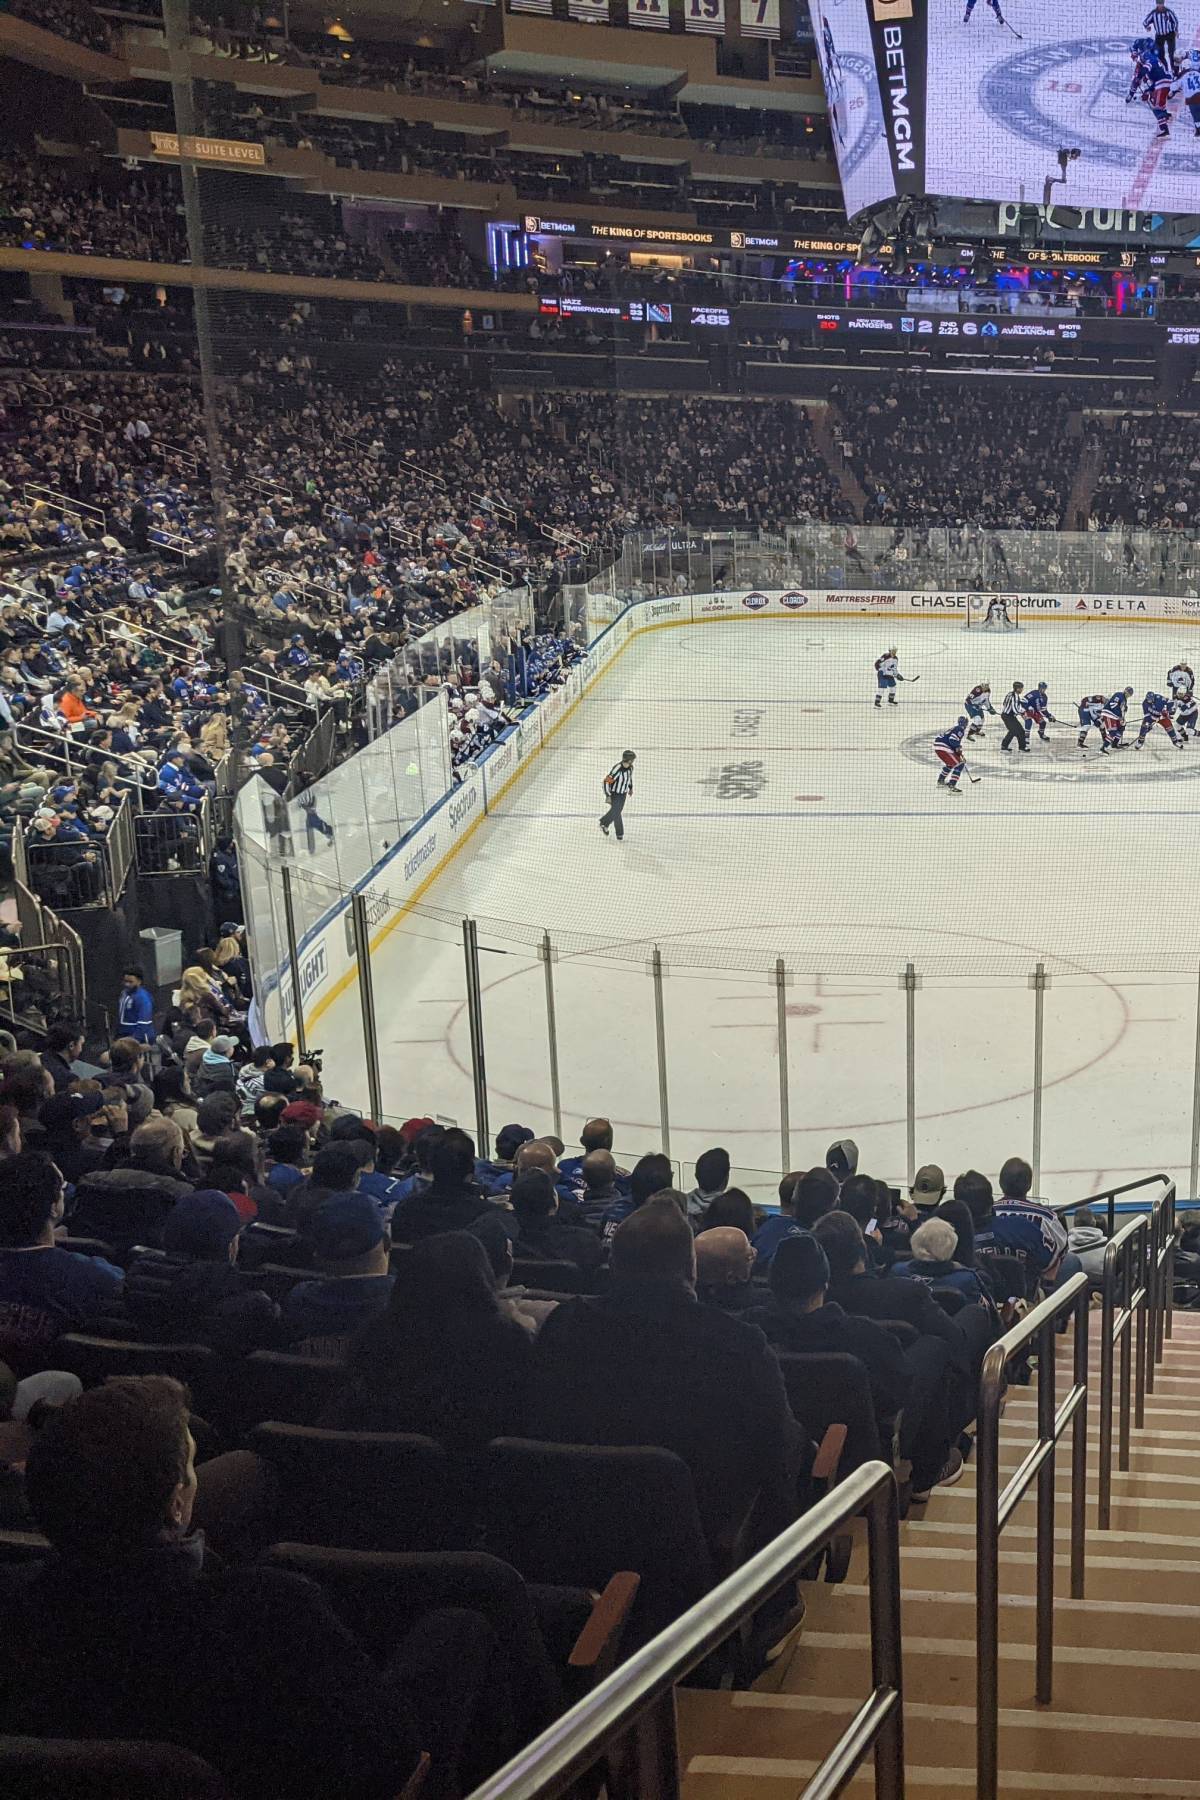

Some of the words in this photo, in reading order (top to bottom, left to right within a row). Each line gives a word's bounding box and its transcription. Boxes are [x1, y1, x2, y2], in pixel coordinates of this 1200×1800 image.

[883, 26, 915, 170] BETMGM
[195, 143, 226, 156] SUITE
[229, 147, 260, 159] LEVEL
[540, 221, 575, 232] BETMGM
[591, 226, 609, 235] THE
[609, 227, 633, 237] KING
[634, 229, 646, 238] OF
[646, 230, 713, 243] SPORTSBOOKS
[745, 237, 778, 246] BETMGM
[794, 240, 810, 249] THE
[810, 241, 833, 250] KING
[834, 242, 846, 251] OF
[562, 305, 621, 314] TIMBERWOLVES
[848, 322, 893, 330] RANGERS
[918, 320, 933, 333] 2
[962, 322, 977, 335] 6
[671, 541, 697, 550] ULTRA
[783, 596, 804, 605] CLOROX
[911, 595, 966, 608] CHASE
[1093, 599, 1147, 611] DELTA
